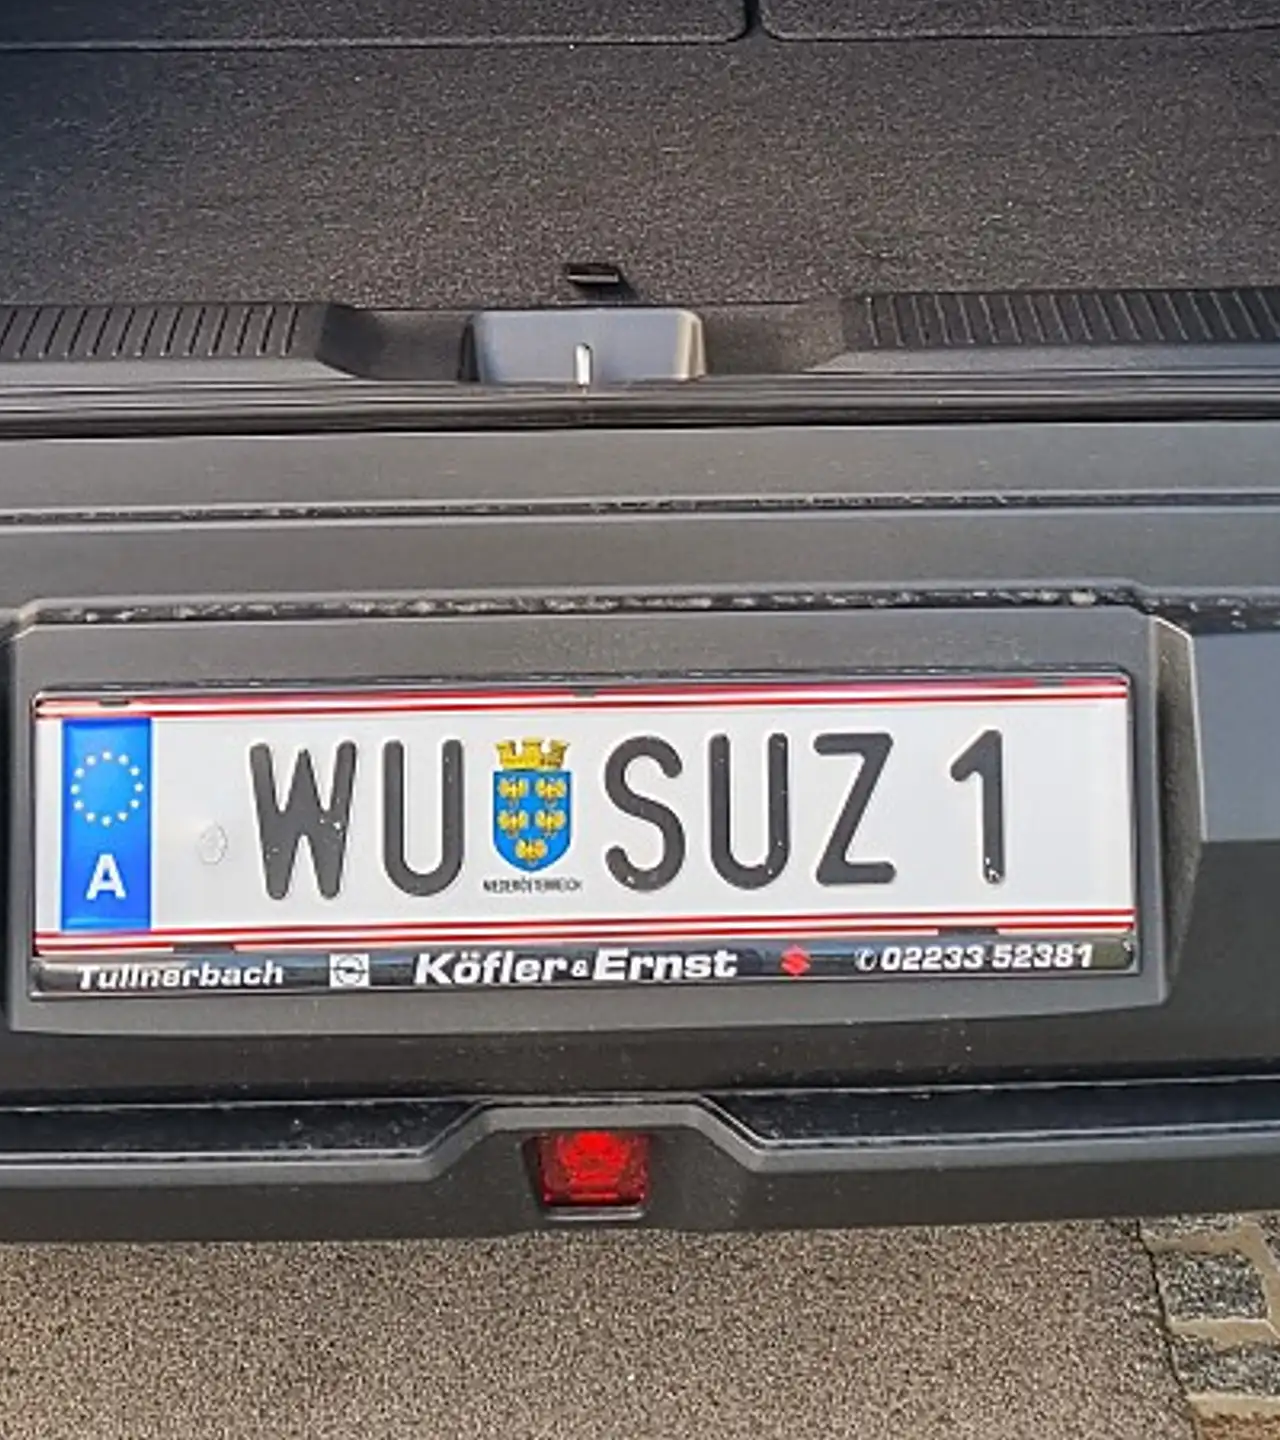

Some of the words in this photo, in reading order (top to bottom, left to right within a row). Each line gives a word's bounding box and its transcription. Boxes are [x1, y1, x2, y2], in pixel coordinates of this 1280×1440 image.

[249, 740, 465, 900] WU
[604, 732, 897, 892] SUZ
[950, 729, 1004, 884] 1
[85, 854, 127, 900] A
[77, 960, 283, 990] Tullnerbach
[879, 945, 983, 972] 02233
[990, 943, 1094, 969] 52381
